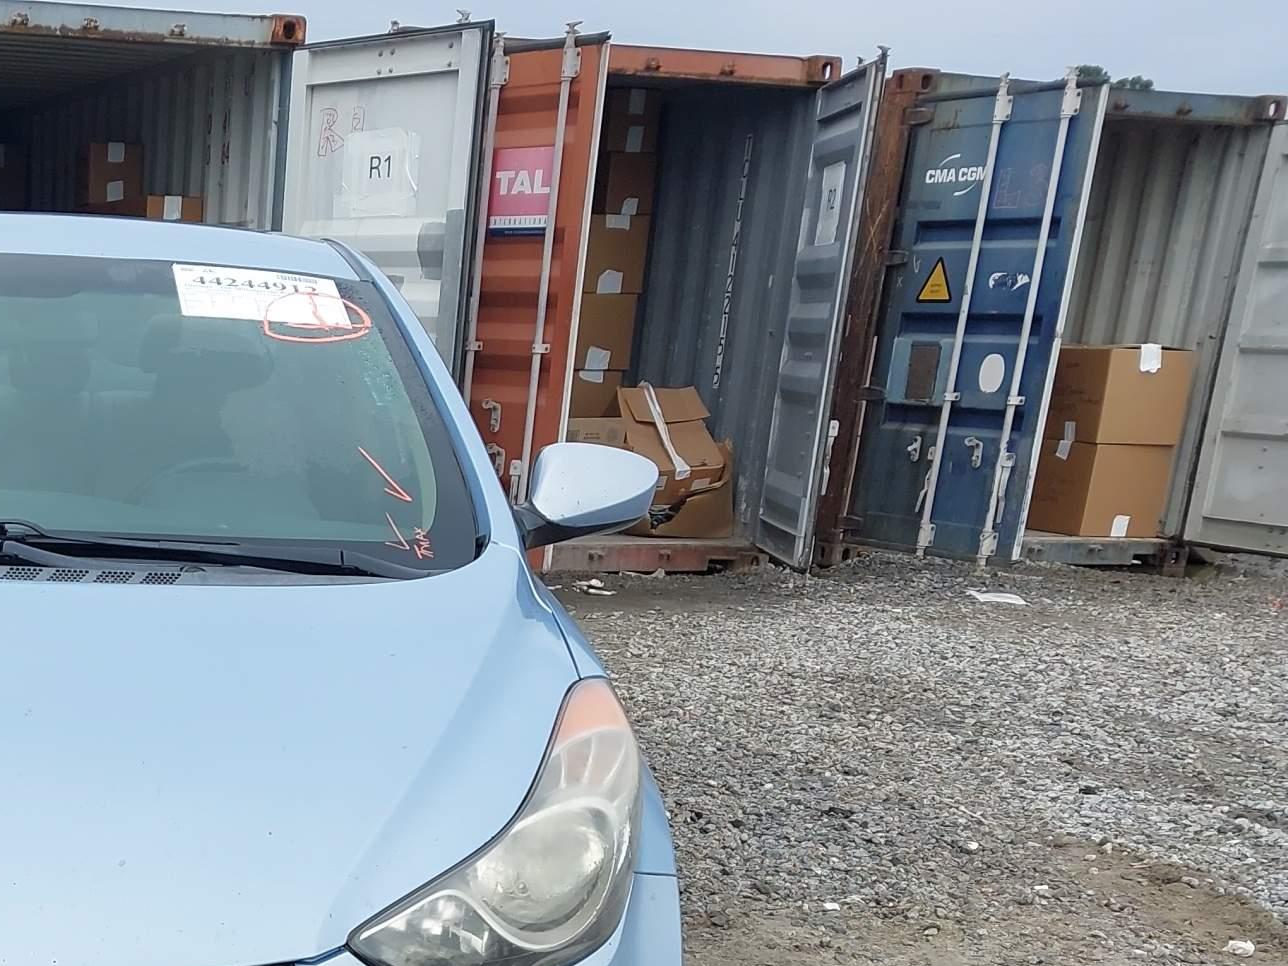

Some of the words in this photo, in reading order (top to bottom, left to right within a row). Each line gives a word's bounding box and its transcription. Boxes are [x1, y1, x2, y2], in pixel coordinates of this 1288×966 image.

[369, 155, 393, 179] R1
[925, 168, 956, 183] CMA
[495, 170, 551, 195] TAL
[192, 276, 317, 296] 44244912
